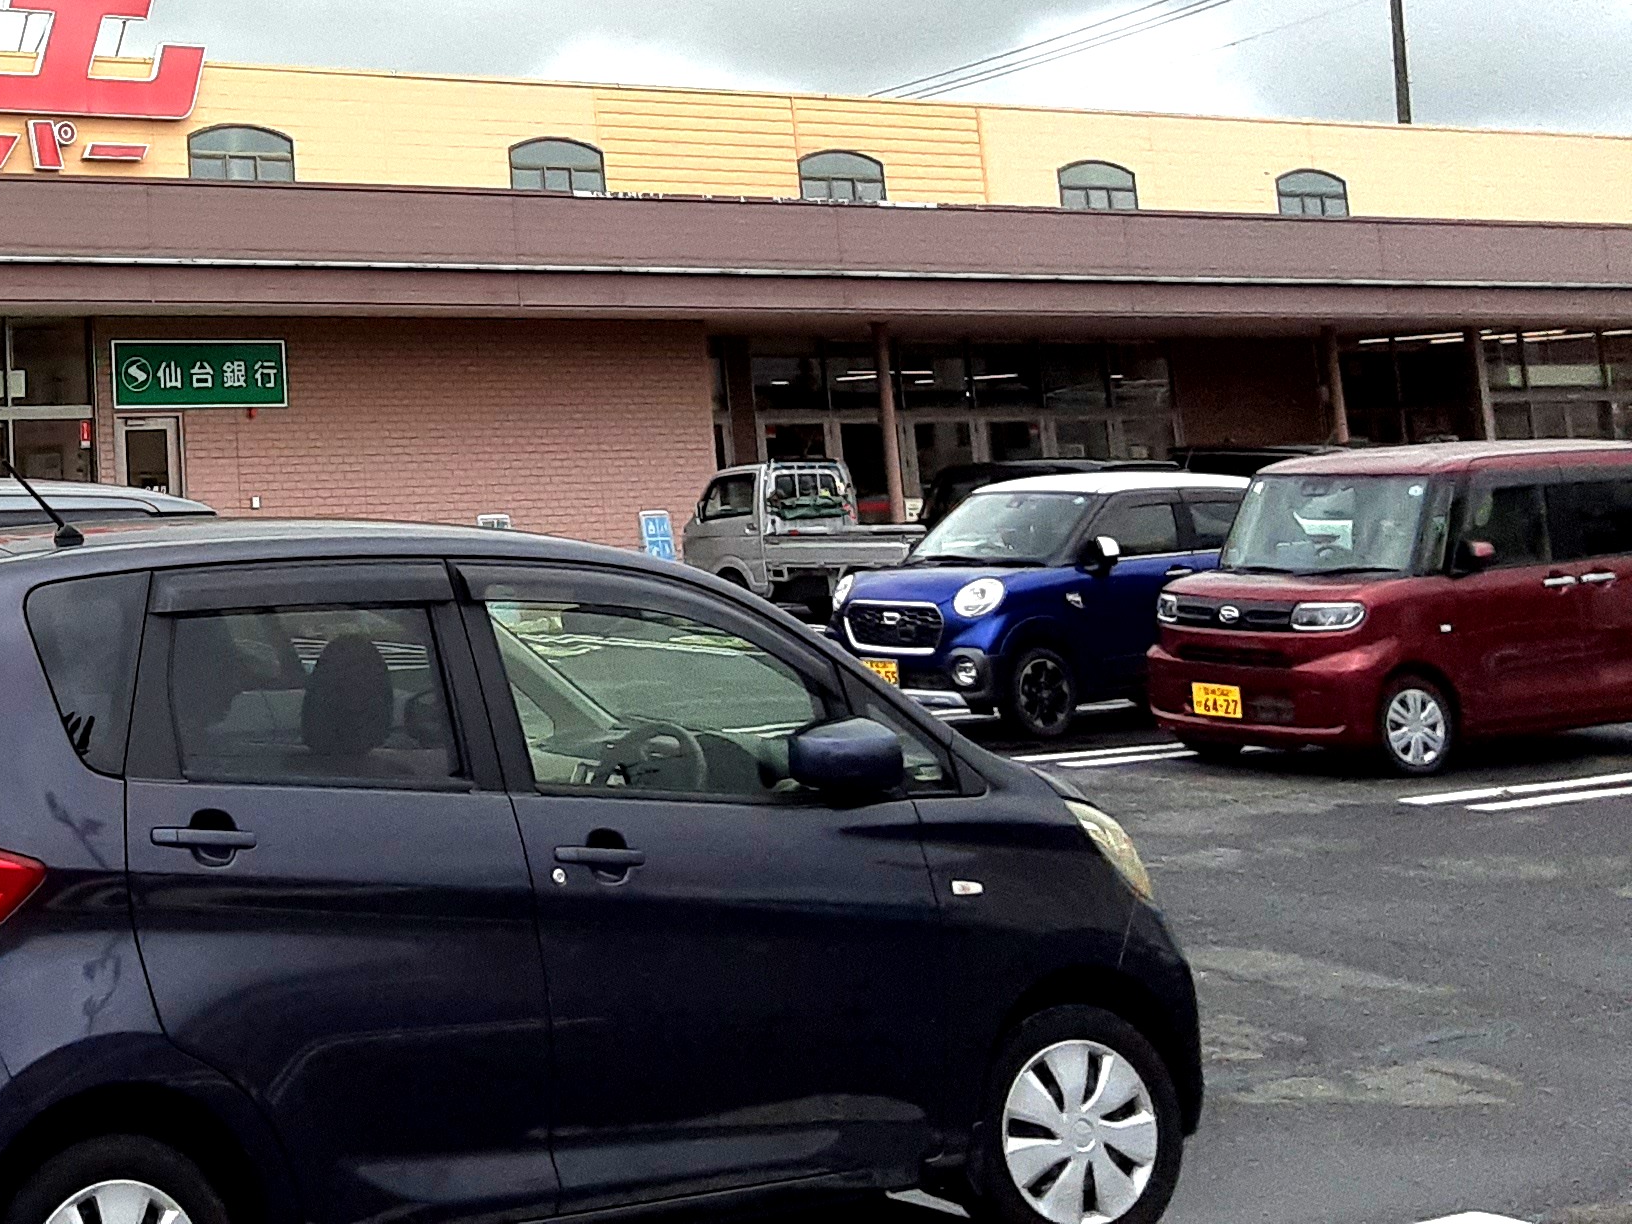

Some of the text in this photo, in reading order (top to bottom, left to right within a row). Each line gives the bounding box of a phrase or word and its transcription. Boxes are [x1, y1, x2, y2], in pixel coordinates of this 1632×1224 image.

[156, 360, 278, 389] 仙台銀行
[1203, 697, 1239, 716] 64-27
